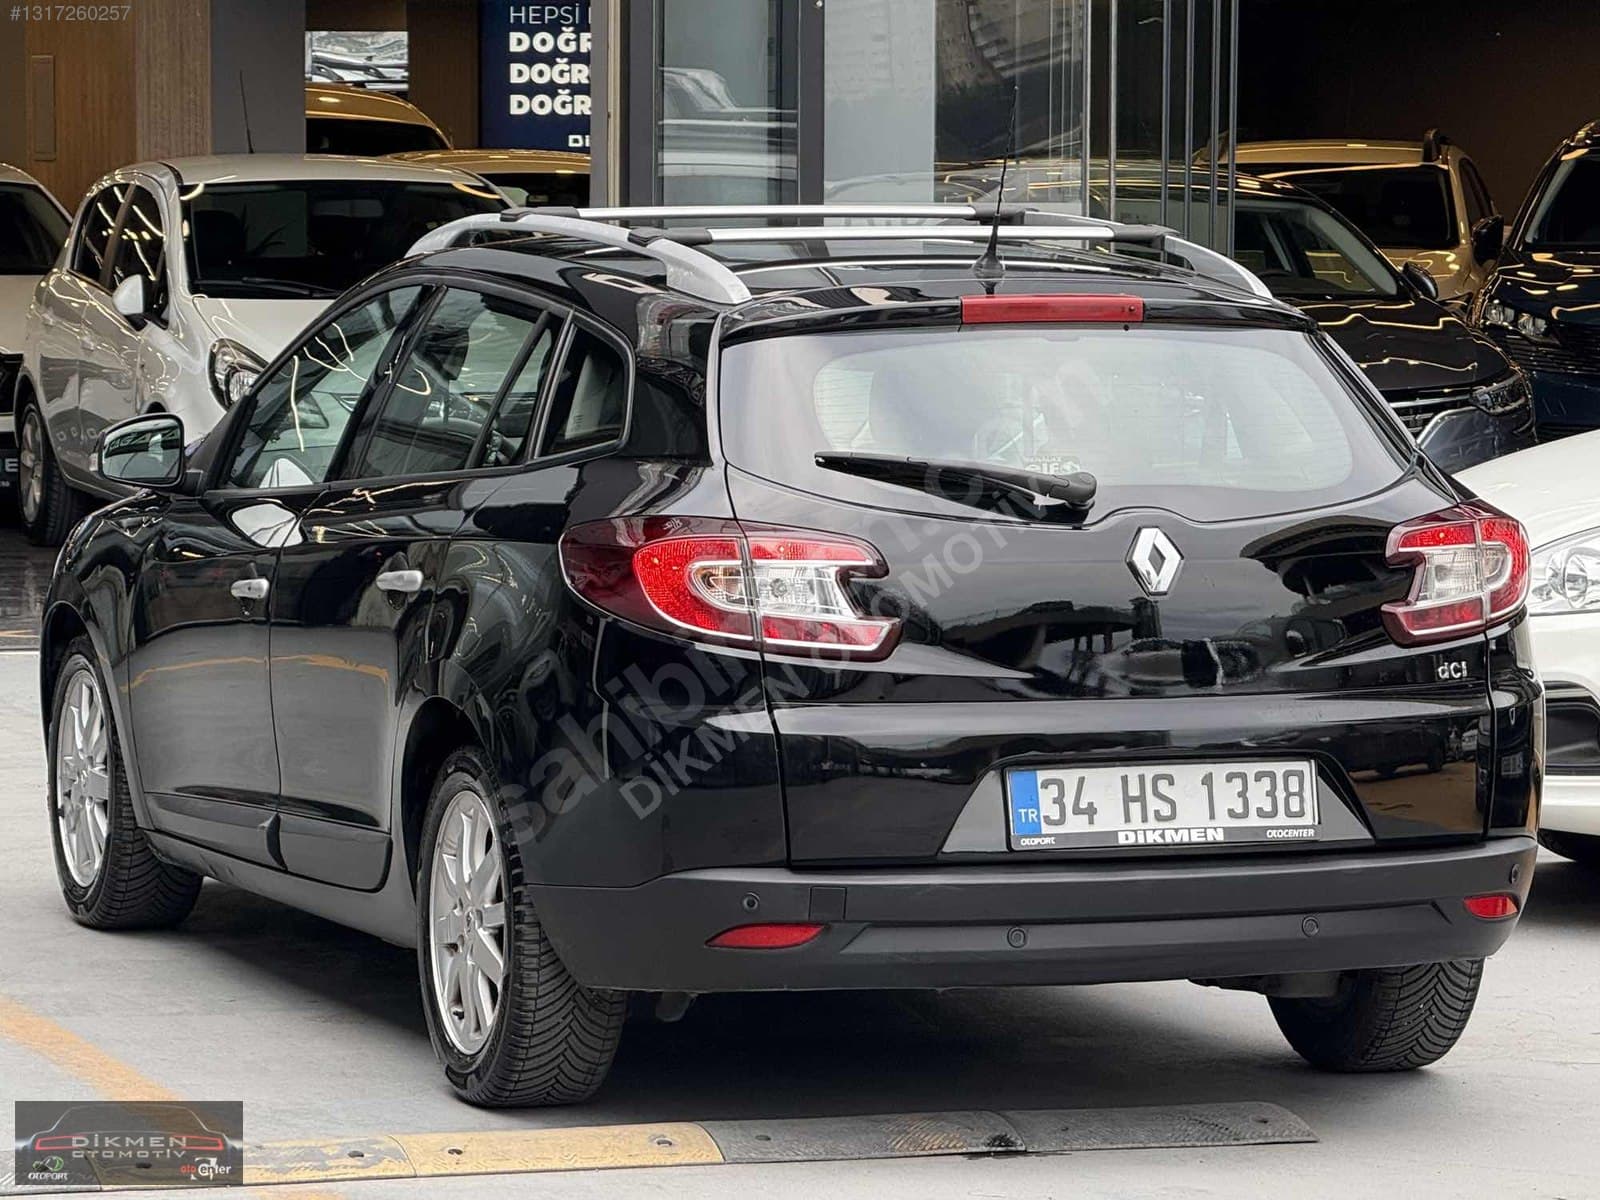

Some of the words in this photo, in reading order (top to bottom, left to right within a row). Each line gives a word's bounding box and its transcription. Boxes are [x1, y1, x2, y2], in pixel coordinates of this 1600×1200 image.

[510, 3, 580, 24] HEPSİ
[1040, 776, 1098, 826] 34
[1120, 773, 1177, 824] HS
[1201, 769, 1306, 820] 1338
[1018, 808, 1038, 823] TR
